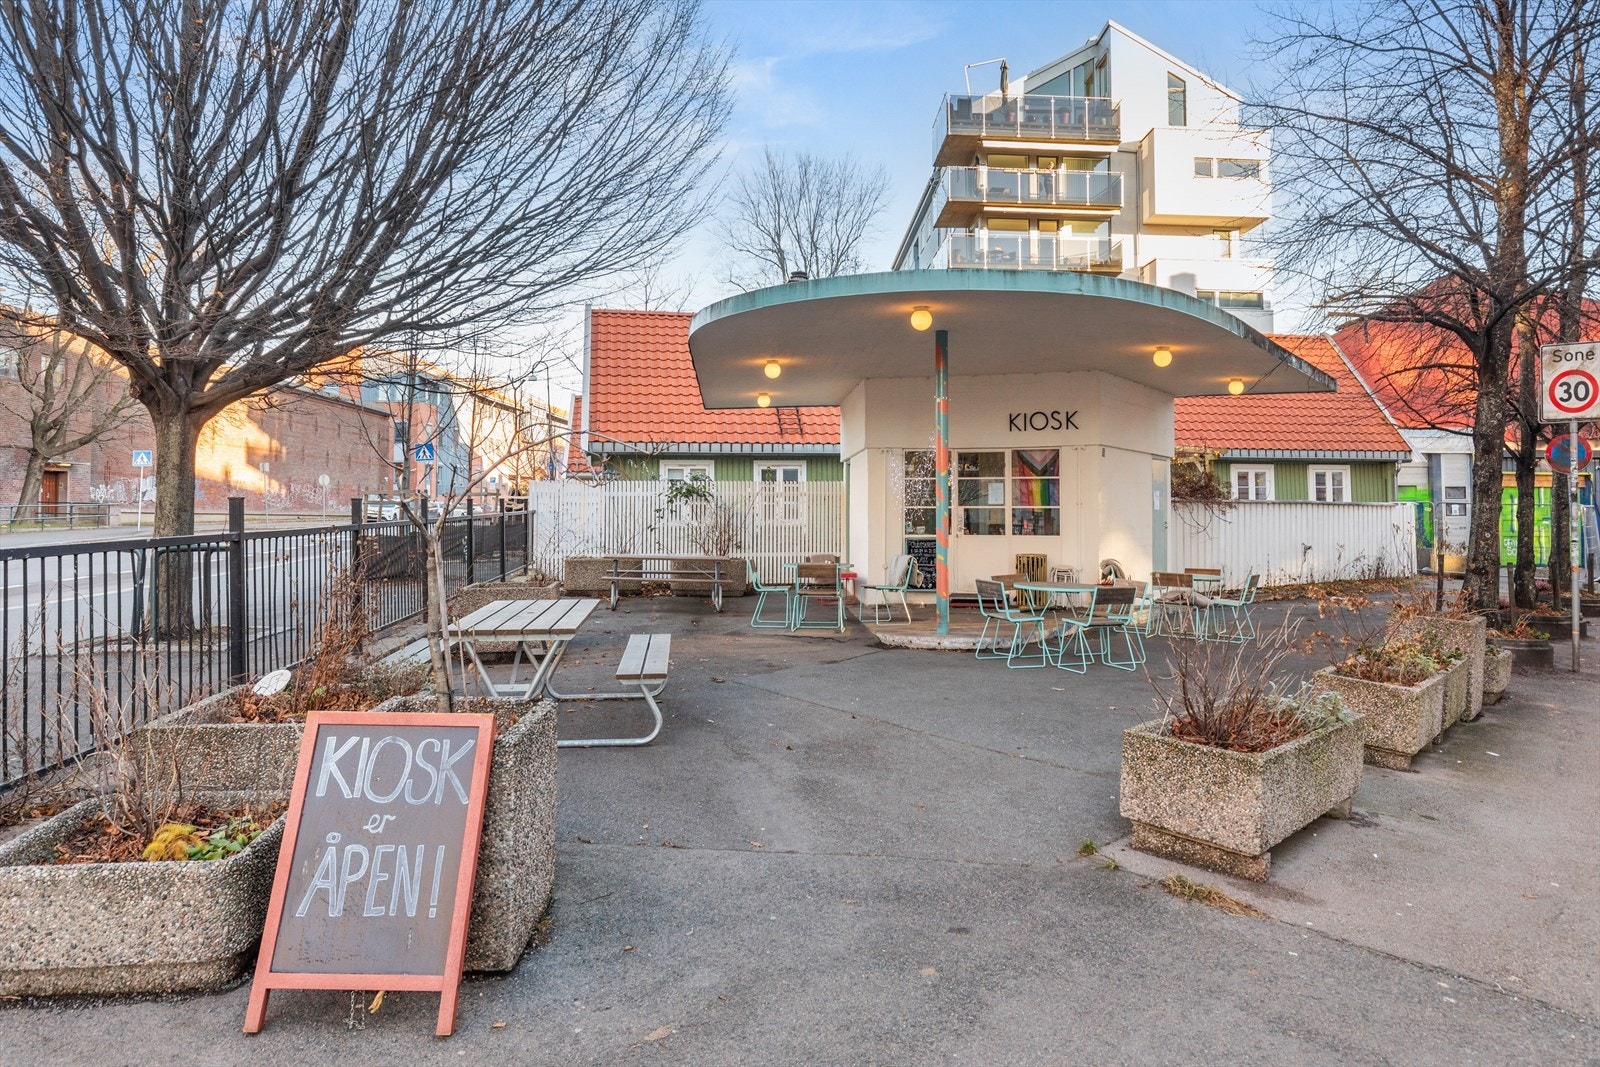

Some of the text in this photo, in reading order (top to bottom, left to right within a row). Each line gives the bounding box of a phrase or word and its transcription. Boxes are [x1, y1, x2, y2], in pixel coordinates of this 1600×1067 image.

[1552, 349, 1595, 363] Sone
[1558, 380, 1590, 403] 30
[1009, 410, 1079, 432] KIOSK
[315, 735, 476, 805] KIOSK
[363, 813, 397, 834] er
